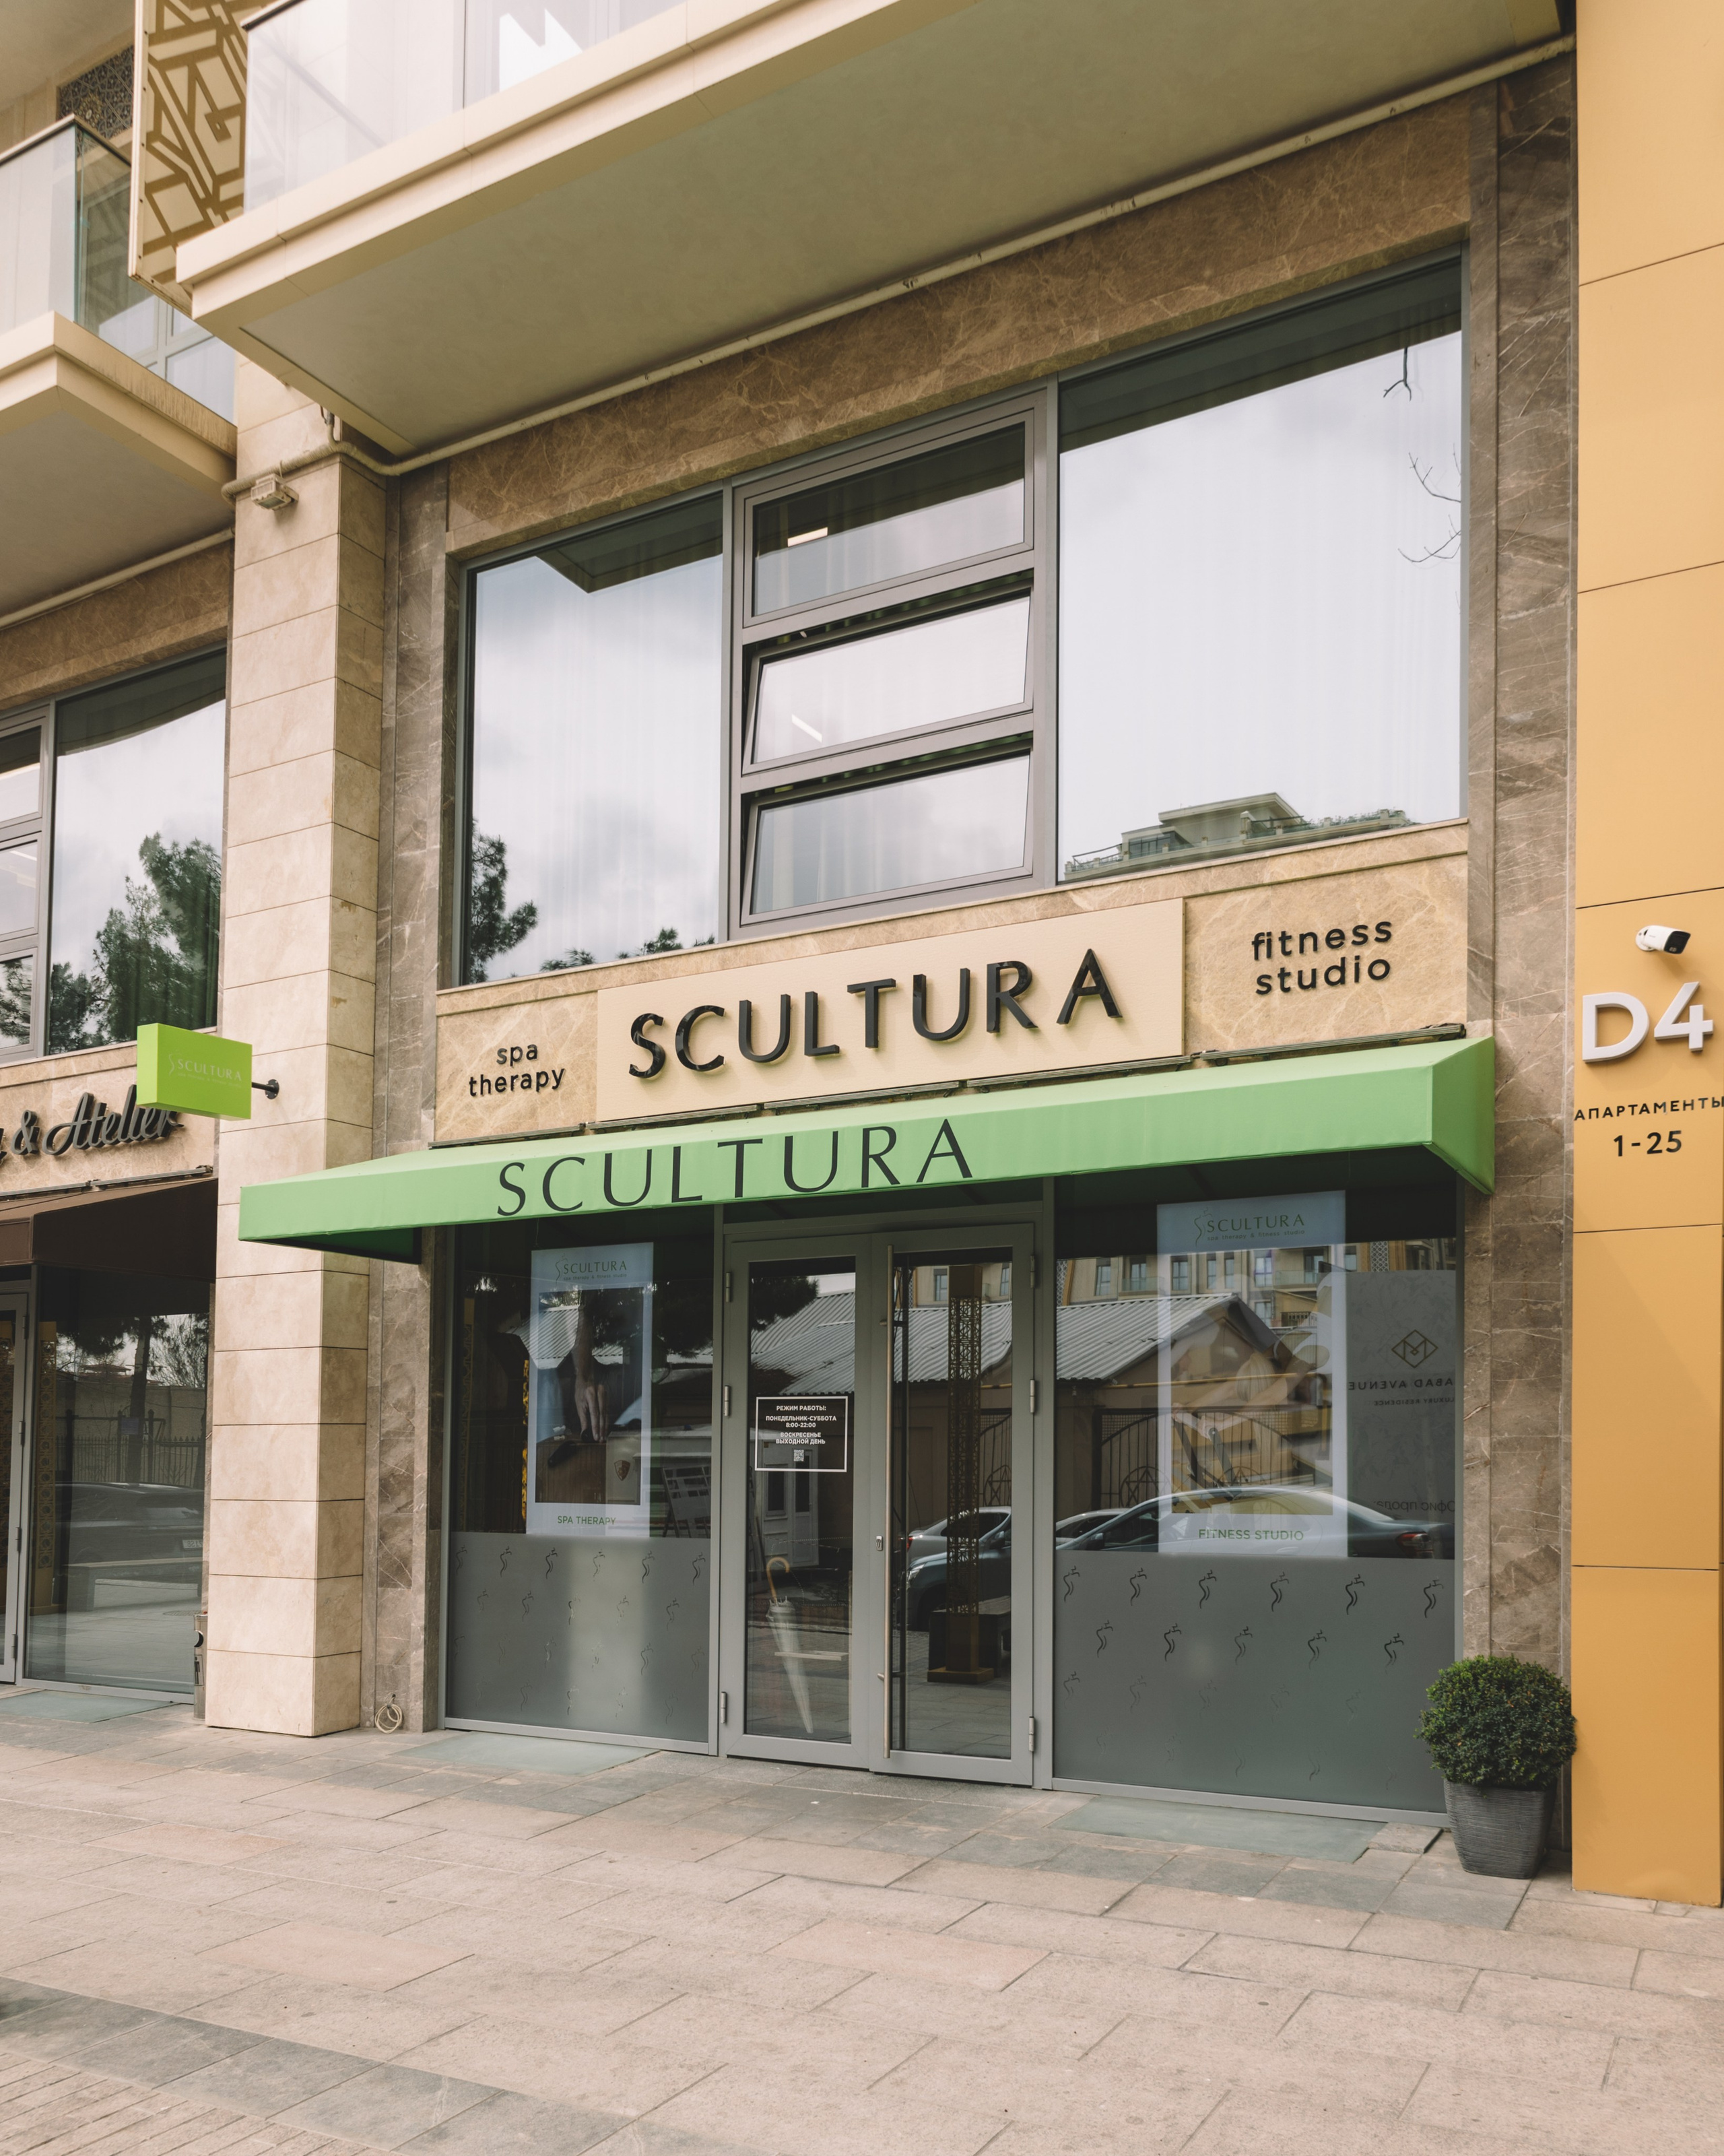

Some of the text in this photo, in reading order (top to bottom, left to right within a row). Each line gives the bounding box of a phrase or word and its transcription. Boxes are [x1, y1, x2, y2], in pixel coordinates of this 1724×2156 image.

[1251, 920, 1393, 961] fitness
[1255, 957, 1391, 995] studio
[628, 948, 1123, 1079] SCULTURA
[1582, 981, 1714, 1064] D4
[496, 1043, 539, 1068] spa
[177, 1058, 242, 1081] SCULTURA
[469, 1067, 565, 1098] therapy
[1573, 1096, 1724, 1121] АПАРТАМЕНТЫ
[11, 1109, 40, 1155] &
[1613, 1130, 1683, 1157] 1-25
[496, 1117, 973, 1217] SCULTURA
[1206, 1214, 1305, 1233] SCULTURA
[563, 1260, 628, 1275] SCULTURA
[557, 1515, 616, 1526] SPA THERAPY
[1198, 1529, 1304, 1541] FITNESS STUDIO
